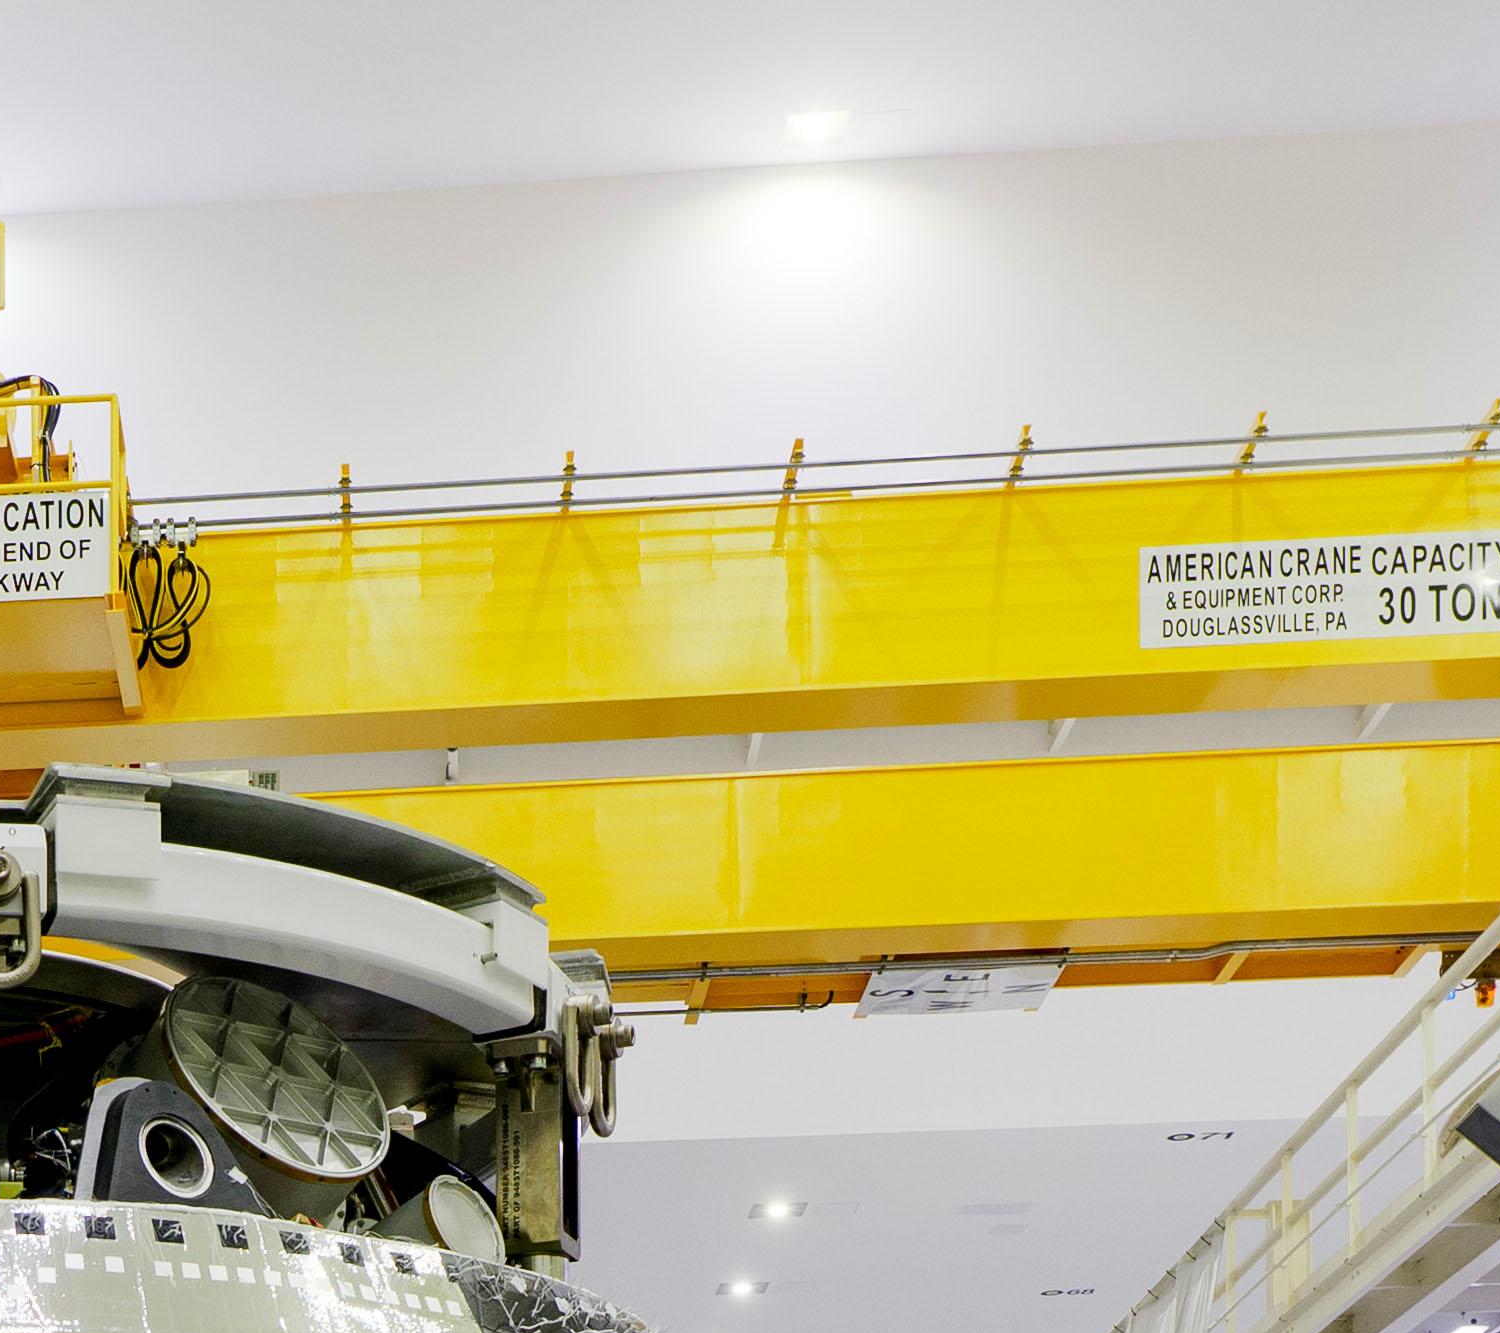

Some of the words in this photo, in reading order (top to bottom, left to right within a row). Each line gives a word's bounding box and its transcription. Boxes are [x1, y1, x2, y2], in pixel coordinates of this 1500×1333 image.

[3, 541, 51, 562] END
[59, 539, 92, 560] OF
[1147, 550, 1273, 584] AMERICAN
[1279, 544, 1362, 577] CRANE
[1165, 591, 1177, 610] &
[1183, 586, 1286, 610] EQUIPMENT
[1291, 583, 1344, 605] CORP.
[1379, 586, 1416, 625] 30
[1162, 613, 1319, 638] DOUGLASSVILLE,
[1325, 611, 1348, 631] PA
[513, 1202, 520, 1212] OF
